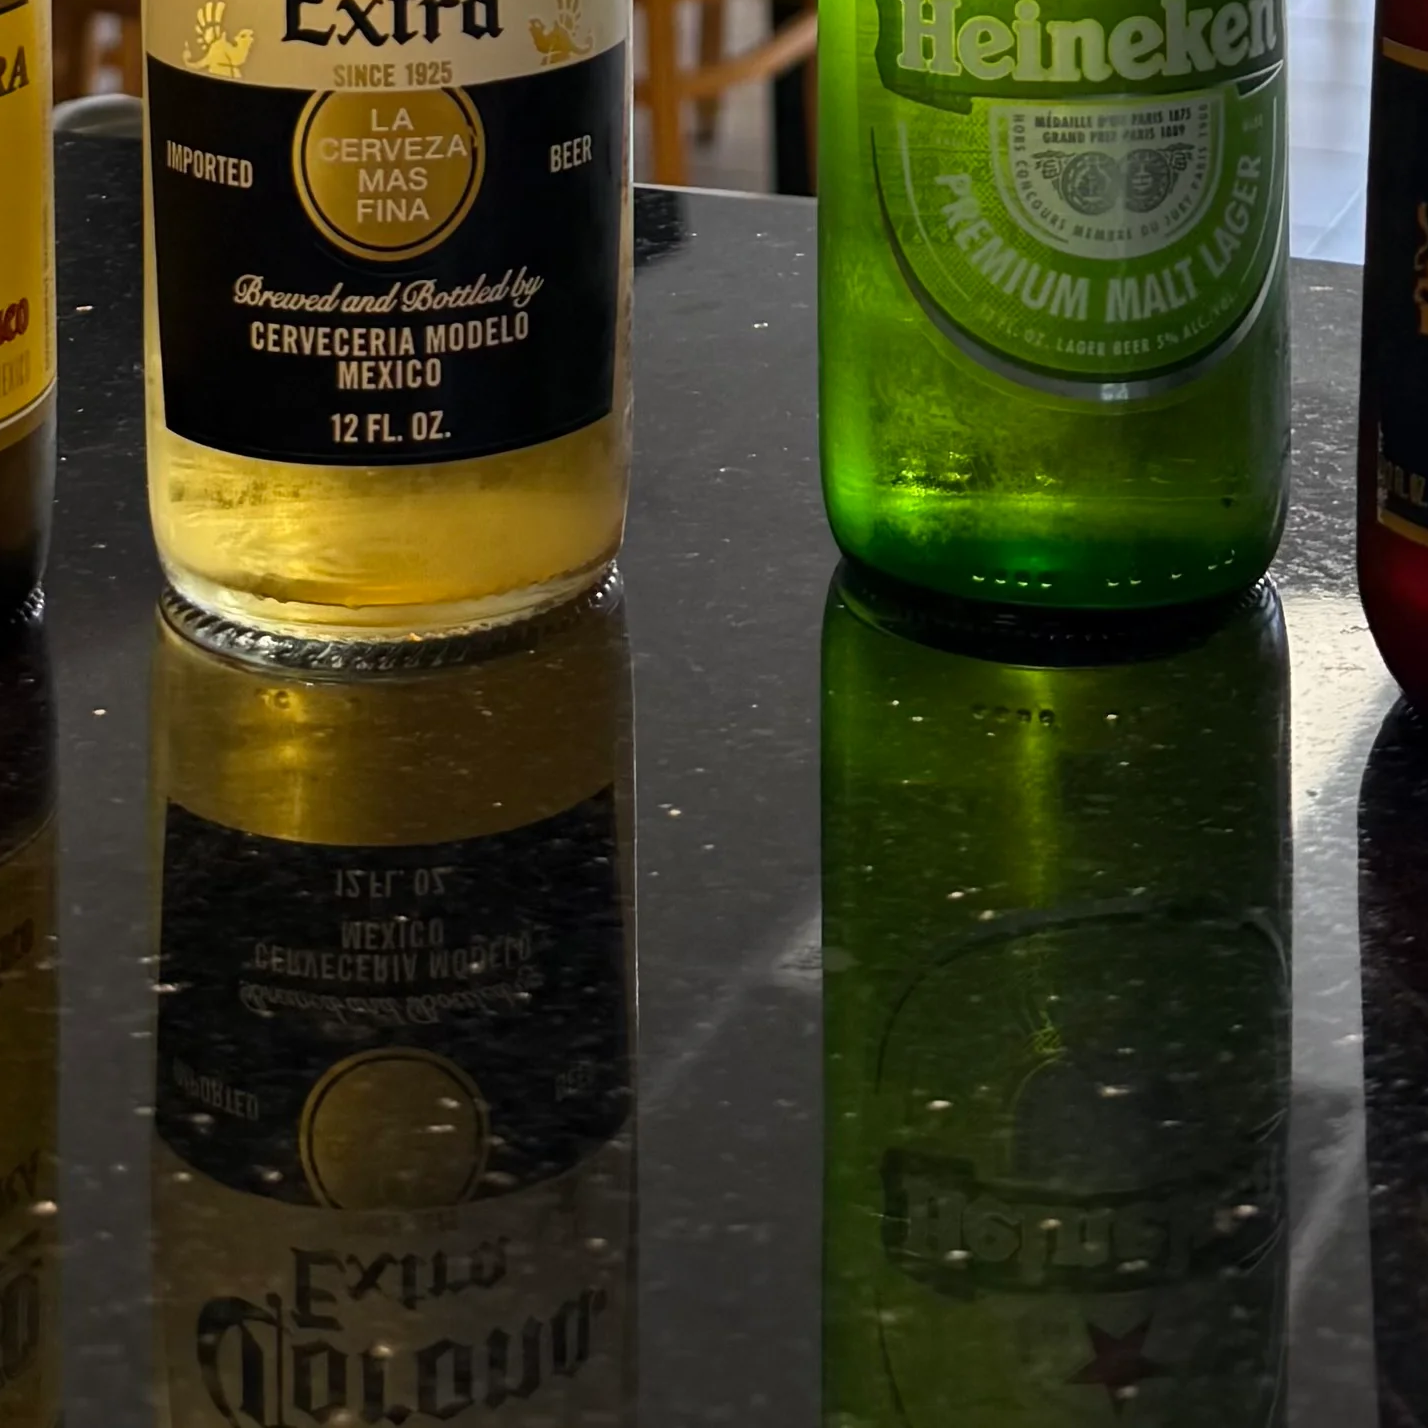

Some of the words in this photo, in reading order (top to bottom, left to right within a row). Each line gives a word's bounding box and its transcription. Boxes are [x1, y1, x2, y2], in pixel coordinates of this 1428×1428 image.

[333, 63, 396, 88] SINCE
[405, 60, 454, 86] 1925
[371, 107, 414, 132] LA
[165, 139, 254, 190] IMPORTED
[318, 134, 469, 164] CERVEZA
[550, 133, 594, 174] BEER
[357, 166, 430, 193] MAS
[355, 198, 431, 224] FINA
[935, 172, 1091, 322] PREMIUM
[1105, 257, 1200, 324] MALT
[1199, 154, 1262, 279] LAGER
[233, 273, 344, 313] Brewed
[341, 282, 401, 313] and
[400, 269, 511, 313] Bottled
[508, 265, 545, 309] by
[249, 320, 416, 357] CERVECERIA
[425, 310, 530, 354] MODELO
[1056, 336, 1107, 358] LAGER
[1112, 335, 1151, 356] BEER
[337, 357, 442, 390] MEXICO
[330, 413, 359, 443] 12
[367, 413, 403, 443] FL.
[411, 410, 452, 441] OZ.
